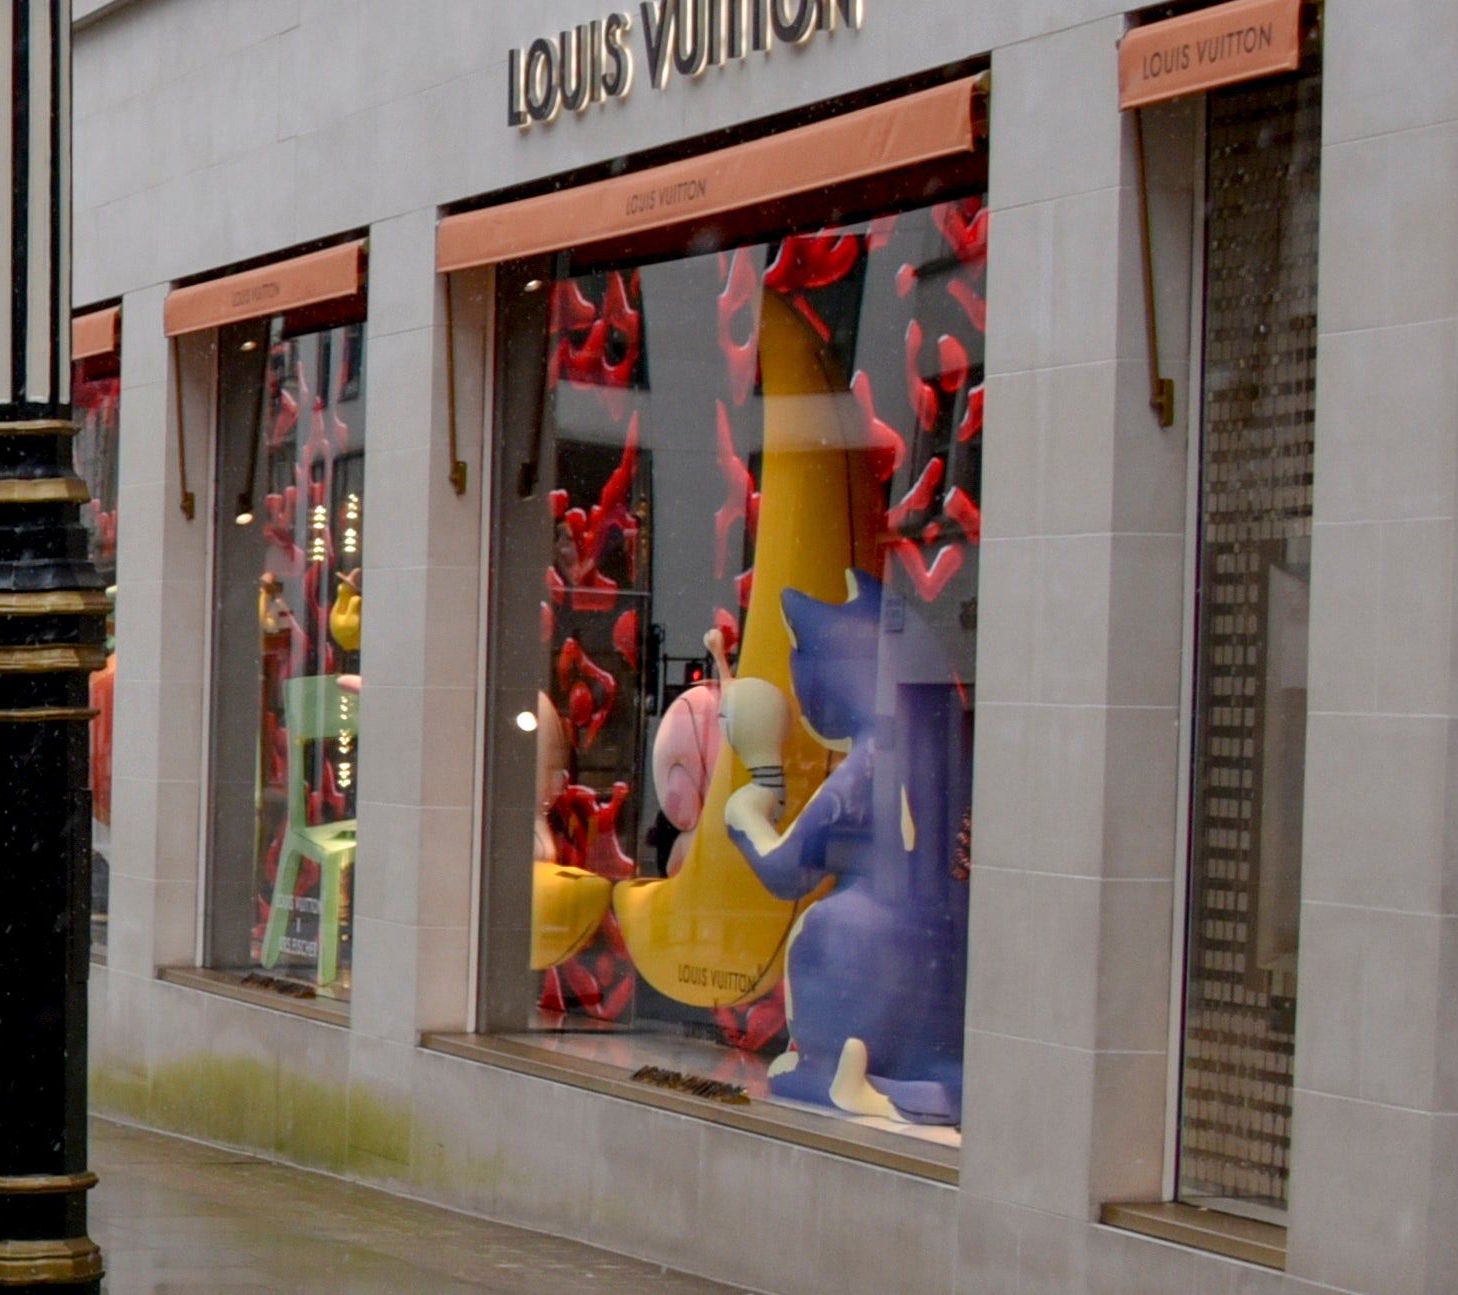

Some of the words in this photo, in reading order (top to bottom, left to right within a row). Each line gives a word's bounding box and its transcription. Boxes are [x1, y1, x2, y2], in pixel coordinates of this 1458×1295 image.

[507, 12, 633, 128] LOUIS
[1142, 44, 1190, 80] LOUIS
[1197, 21, 1273, 64] VUITTON
[625, 190, 656, 216] LOUIS
[658, 178, 707, 206] VUITTON
[679, 964, 708, 987] LOUIS
[711, 969, 756, 994] VUITTON
